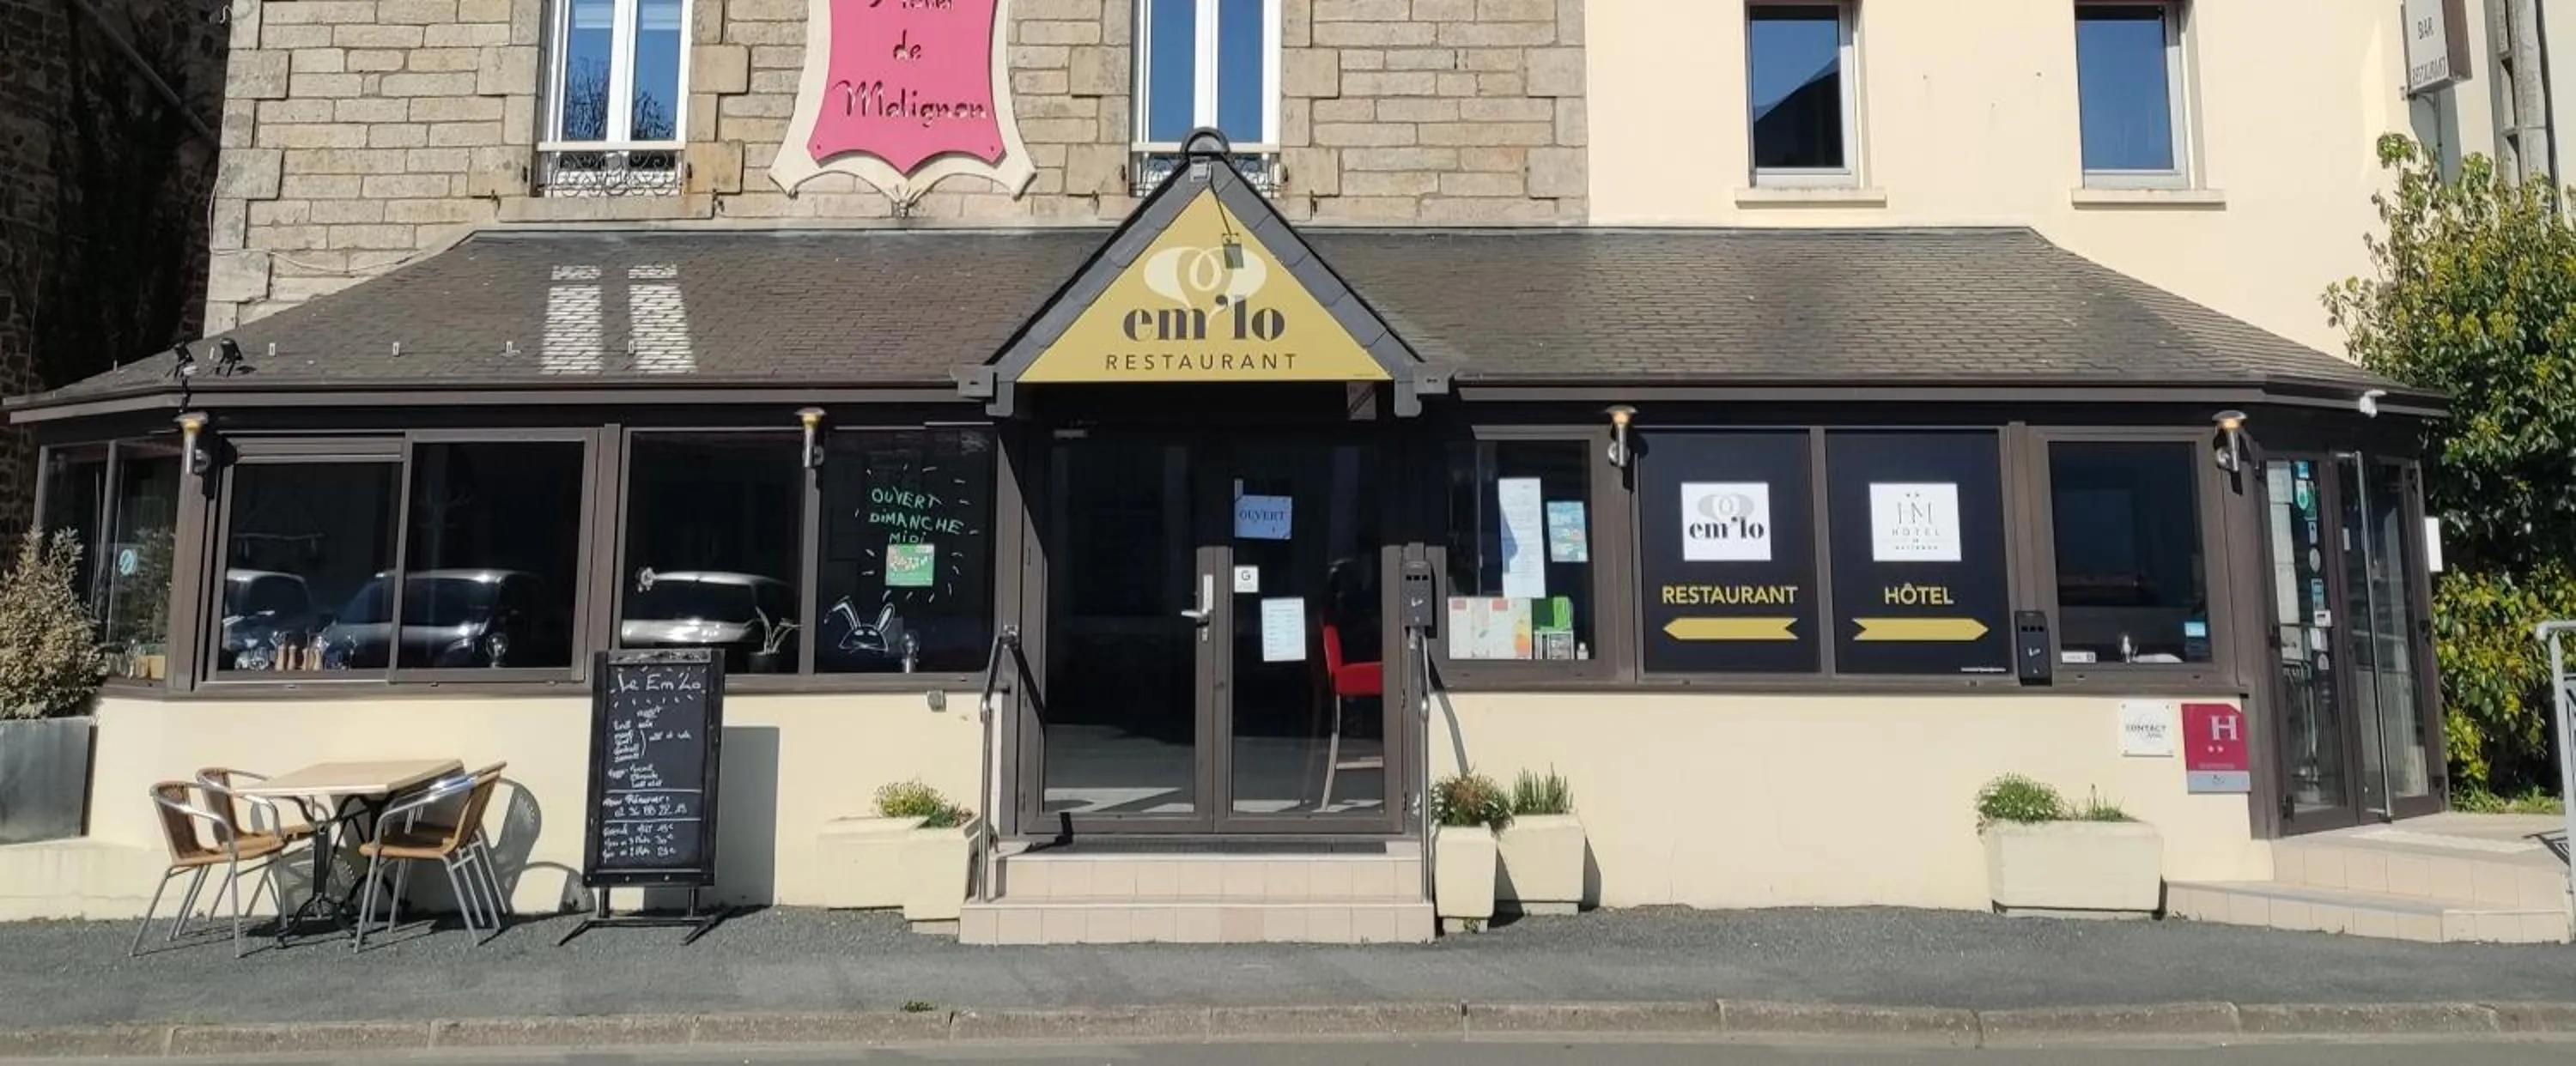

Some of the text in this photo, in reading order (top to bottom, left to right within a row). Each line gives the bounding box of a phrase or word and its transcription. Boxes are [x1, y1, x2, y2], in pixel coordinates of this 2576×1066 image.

[2417, 17, 2433, 39] BAR
[892, 29, 921, 59] de
[1106, 354, 1298, 370] RESTAURANT
[872, 487, 944, 508] OUVERT
[1239, 509, 1285, 522] OUVERT
[1662, 585, 1798, 605] RESTAURANT
[1885, 583, 1953, 605] HÔTEL
[2210, 715, 2239, 741] H
